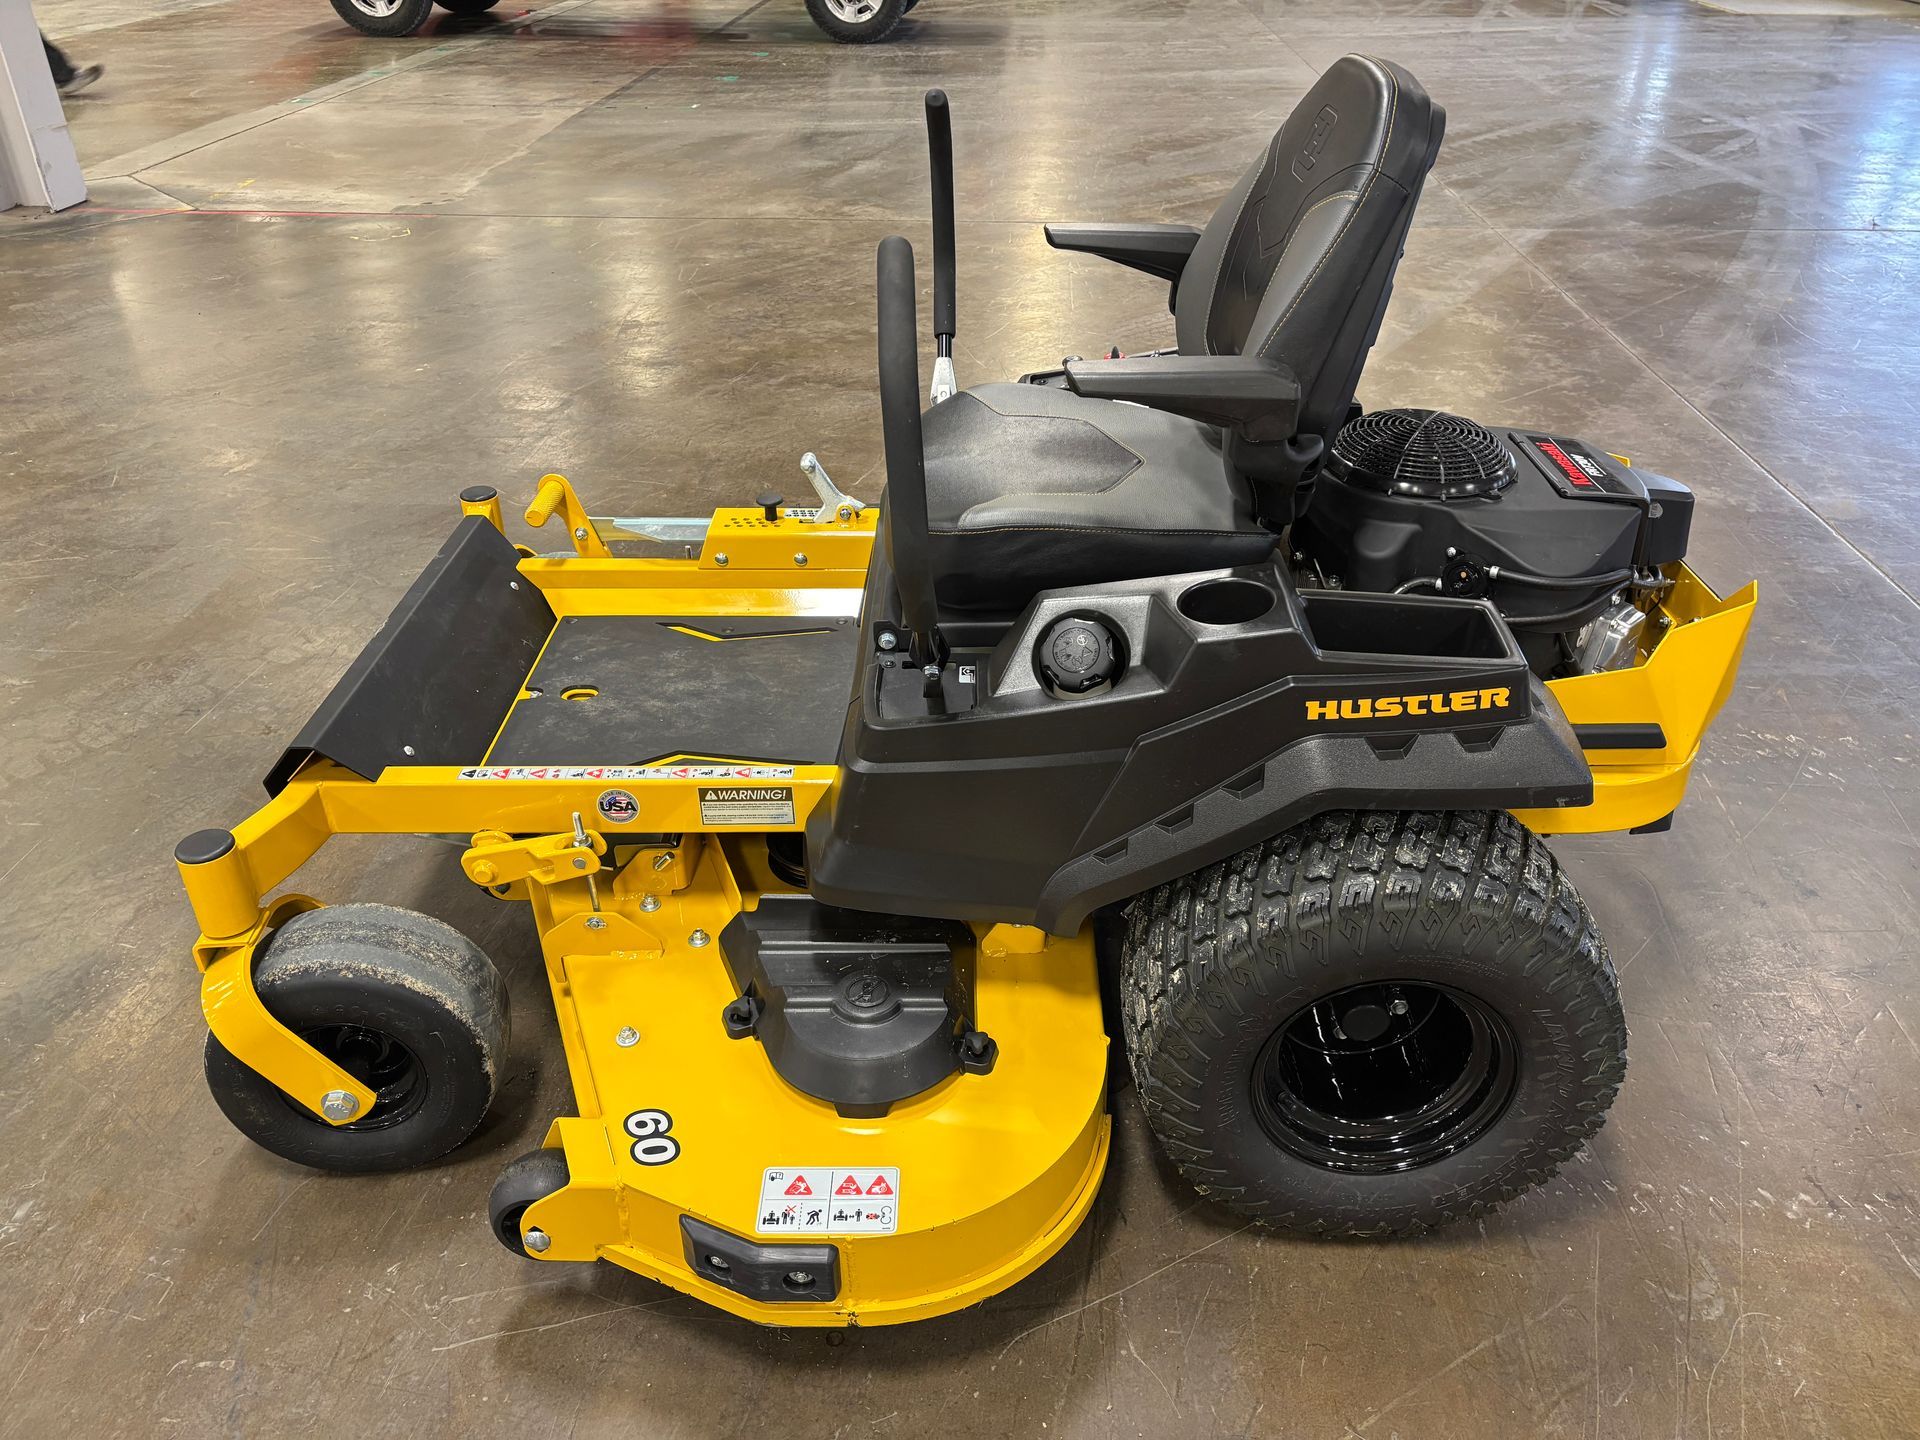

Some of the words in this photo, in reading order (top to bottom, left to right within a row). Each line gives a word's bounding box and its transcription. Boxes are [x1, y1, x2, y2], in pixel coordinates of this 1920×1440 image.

[1535, 442, 1593, 486] Kawasaki
[1305, 687, 1511, 720] HUSTLER
[600, 801, 637, 812] USA
[718, 789, 786, 800] WARNING!
[623, 1108, 681, 1166] 60
